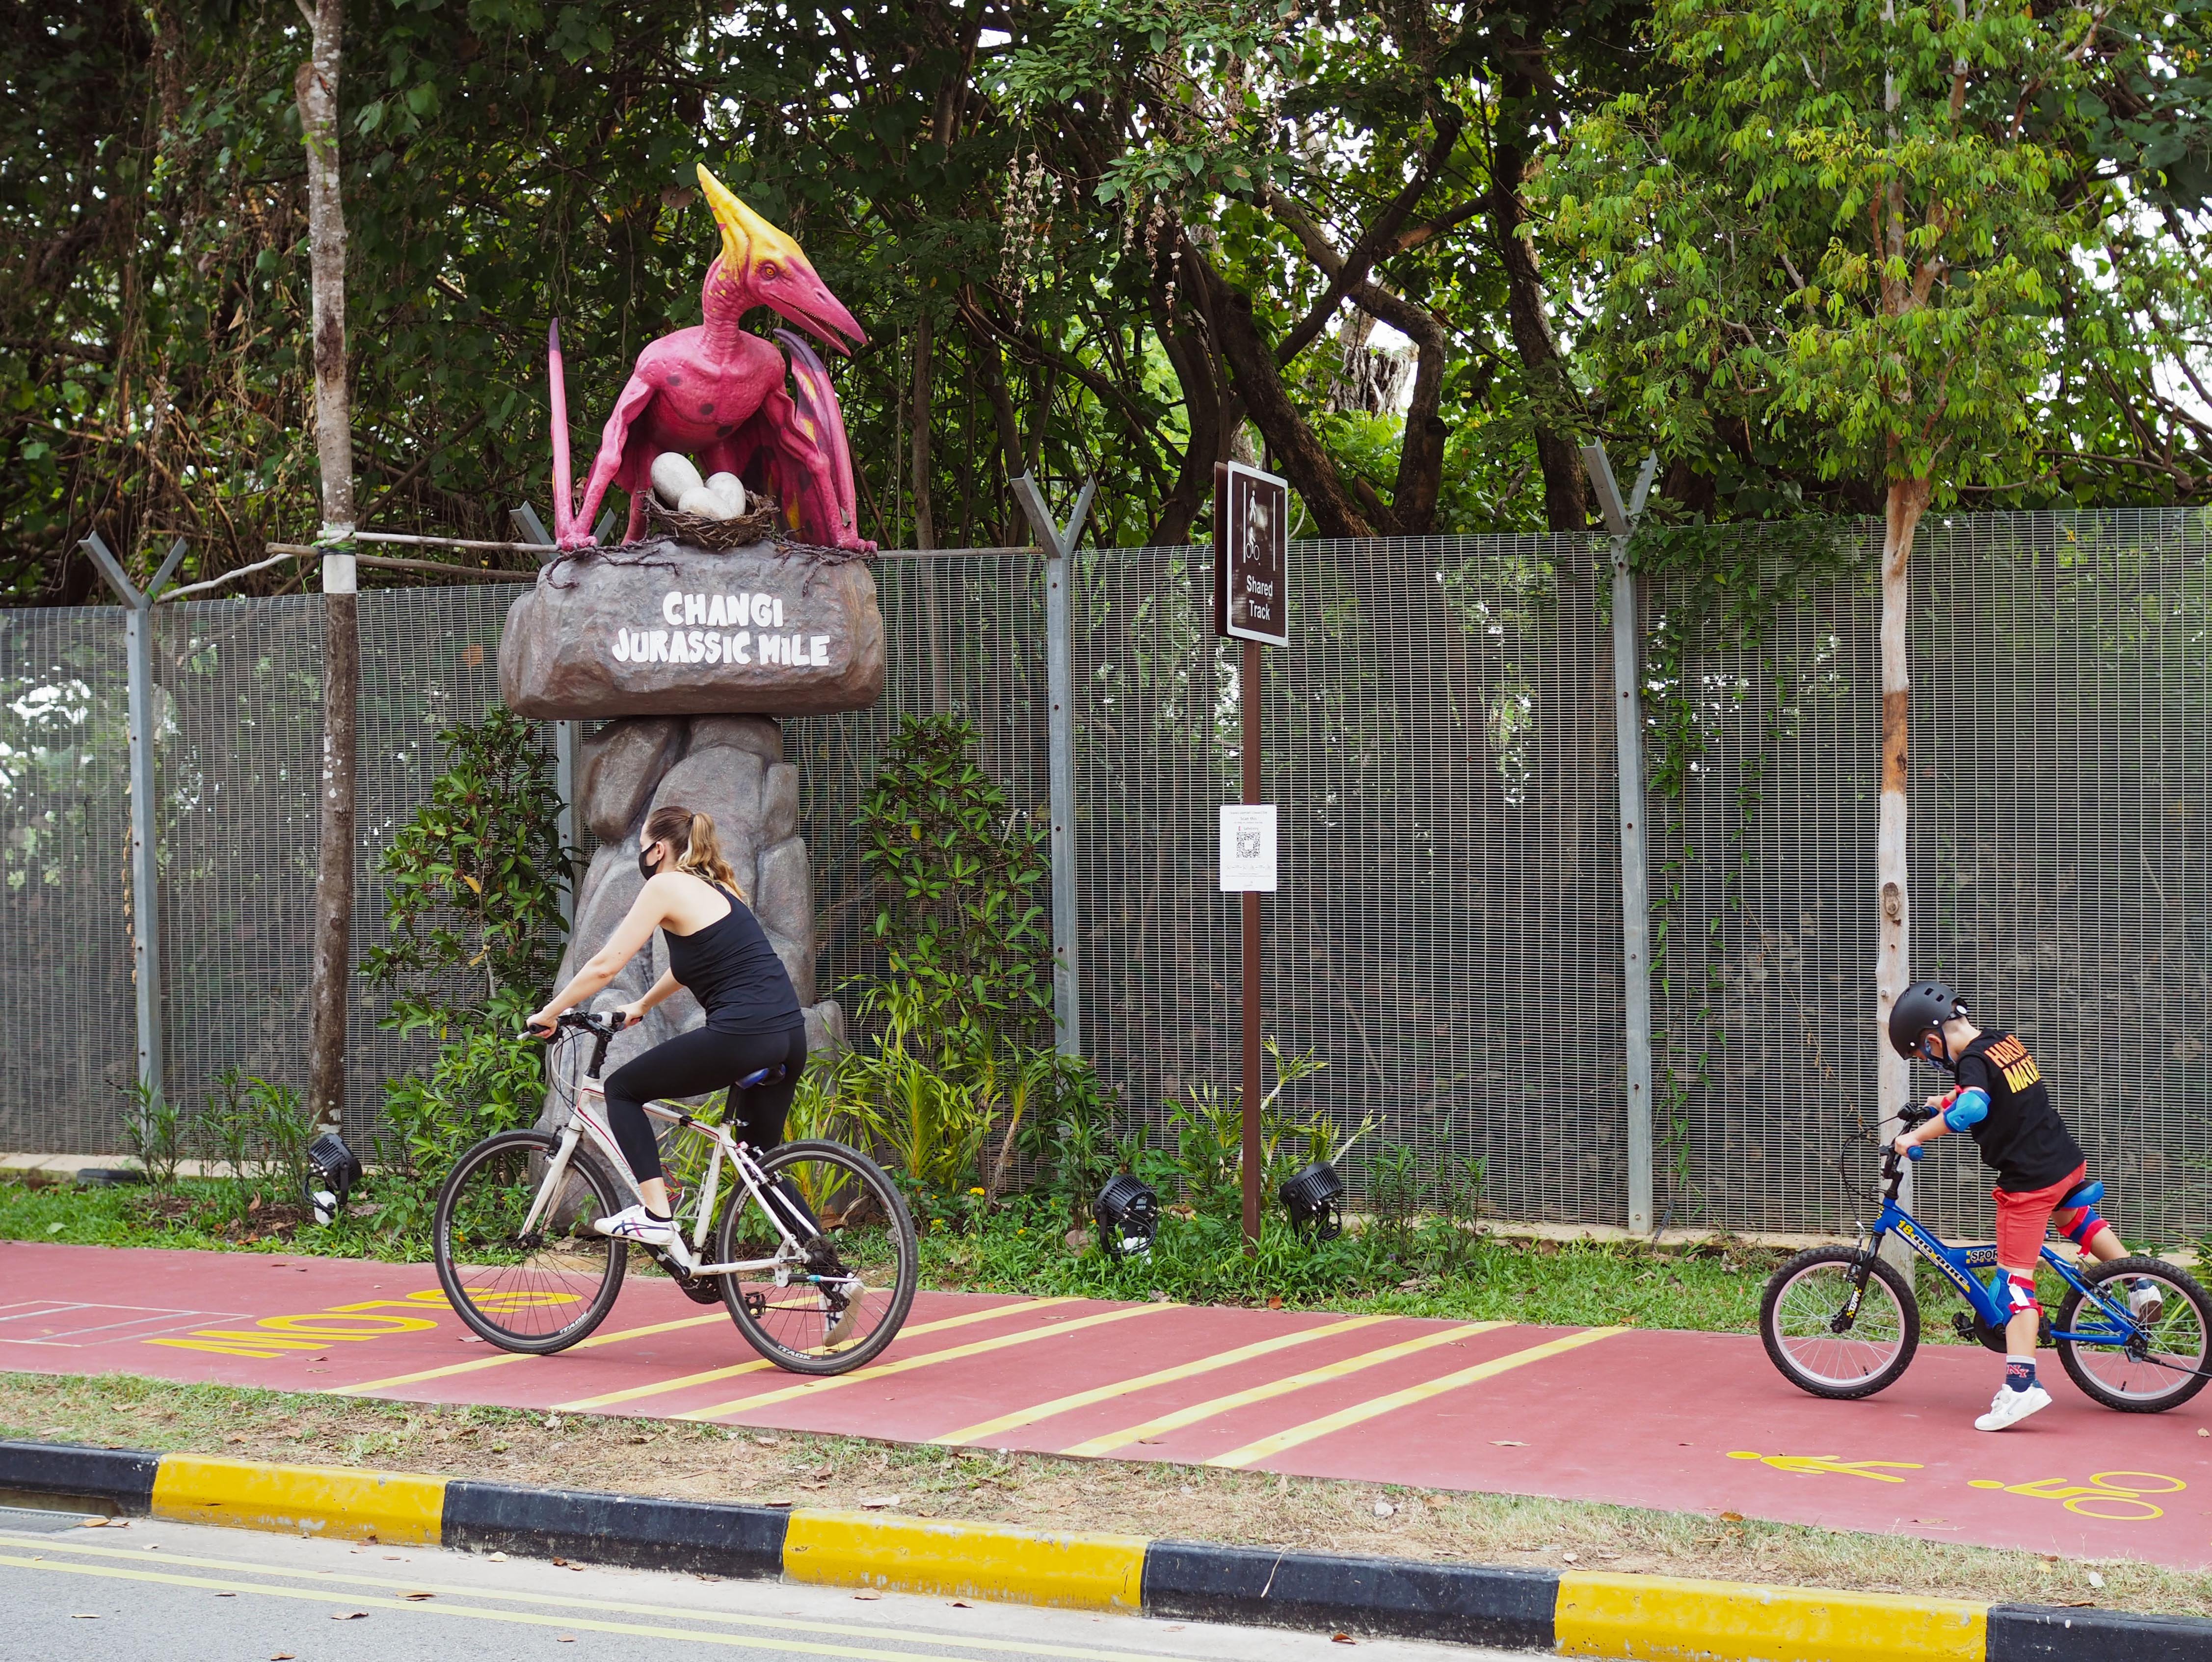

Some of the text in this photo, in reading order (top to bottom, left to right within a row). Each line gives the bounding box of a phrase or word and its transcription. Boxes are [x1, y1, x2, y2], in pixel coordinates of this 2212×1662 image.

[1246, 575, 1273, 597] Shared
[663, 591, 783, 627] CHANGI
[1249, 600, 1270, 621] Track
[612, 628, 830, 666] JURASSIC MILE
[1898, 1220, 1914, 1236] 18
[1936, 1255, 1969, 1285] BIKE
[2007, 1364, 2029, 1378] NY
